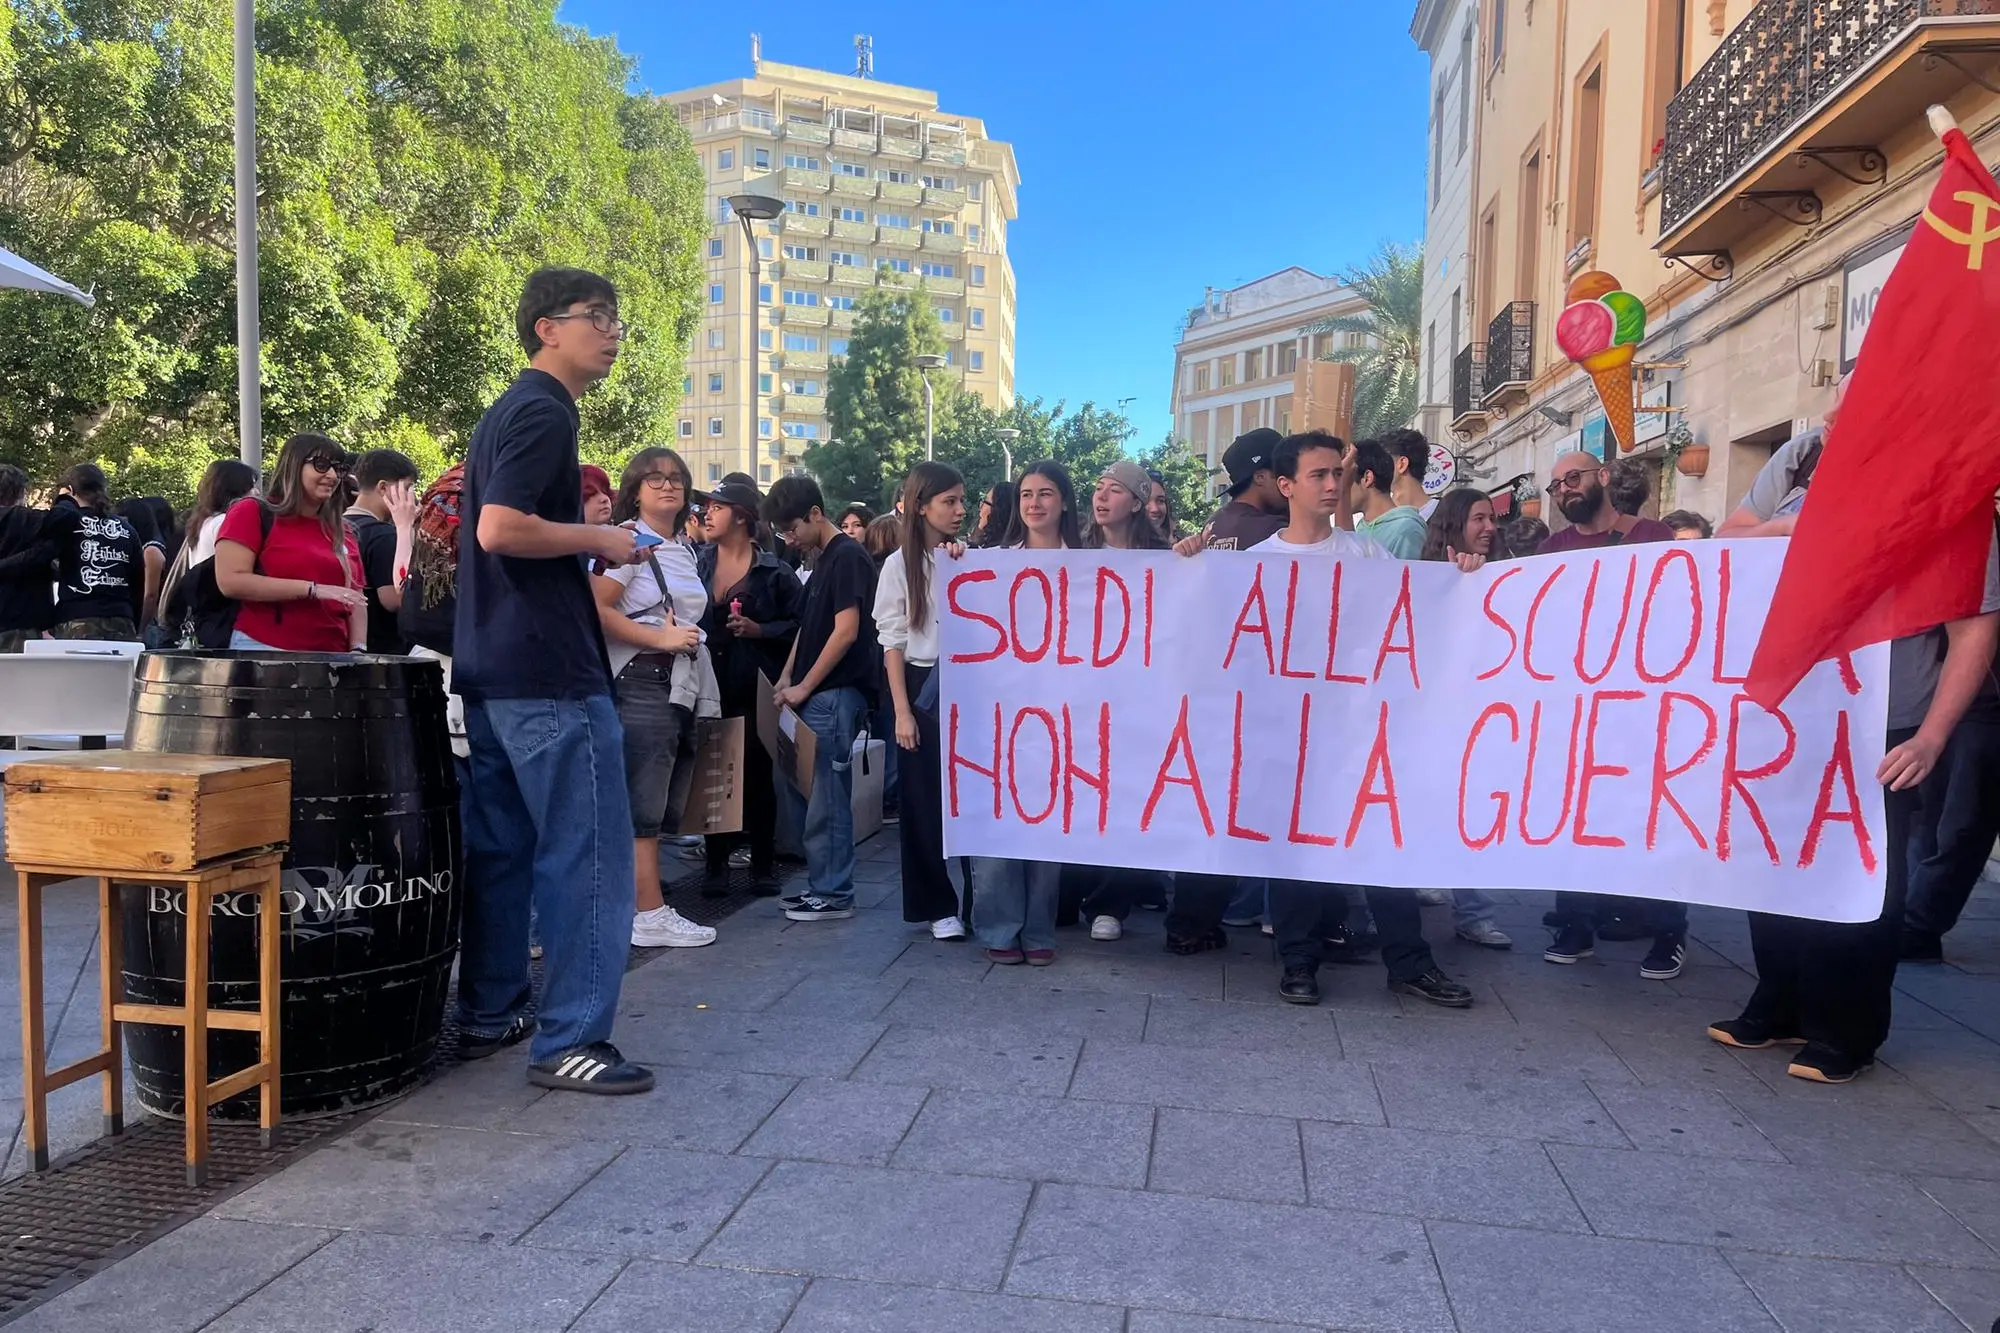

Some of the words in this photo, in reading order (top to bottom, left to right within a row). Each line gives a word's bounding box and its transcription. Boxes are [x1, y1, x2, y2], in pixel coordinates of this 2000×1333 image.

[948, 566, 1153, 668] SOLDI
[1224, 561, 1419, 689] ALLA
[1476, 548, 1862, 696] SCUOL
[1140, 690, 1403, 848] ALLA
[1457, 690, 1878, 875] GUERRA
[313, 869, 452, 914] MOLINO
